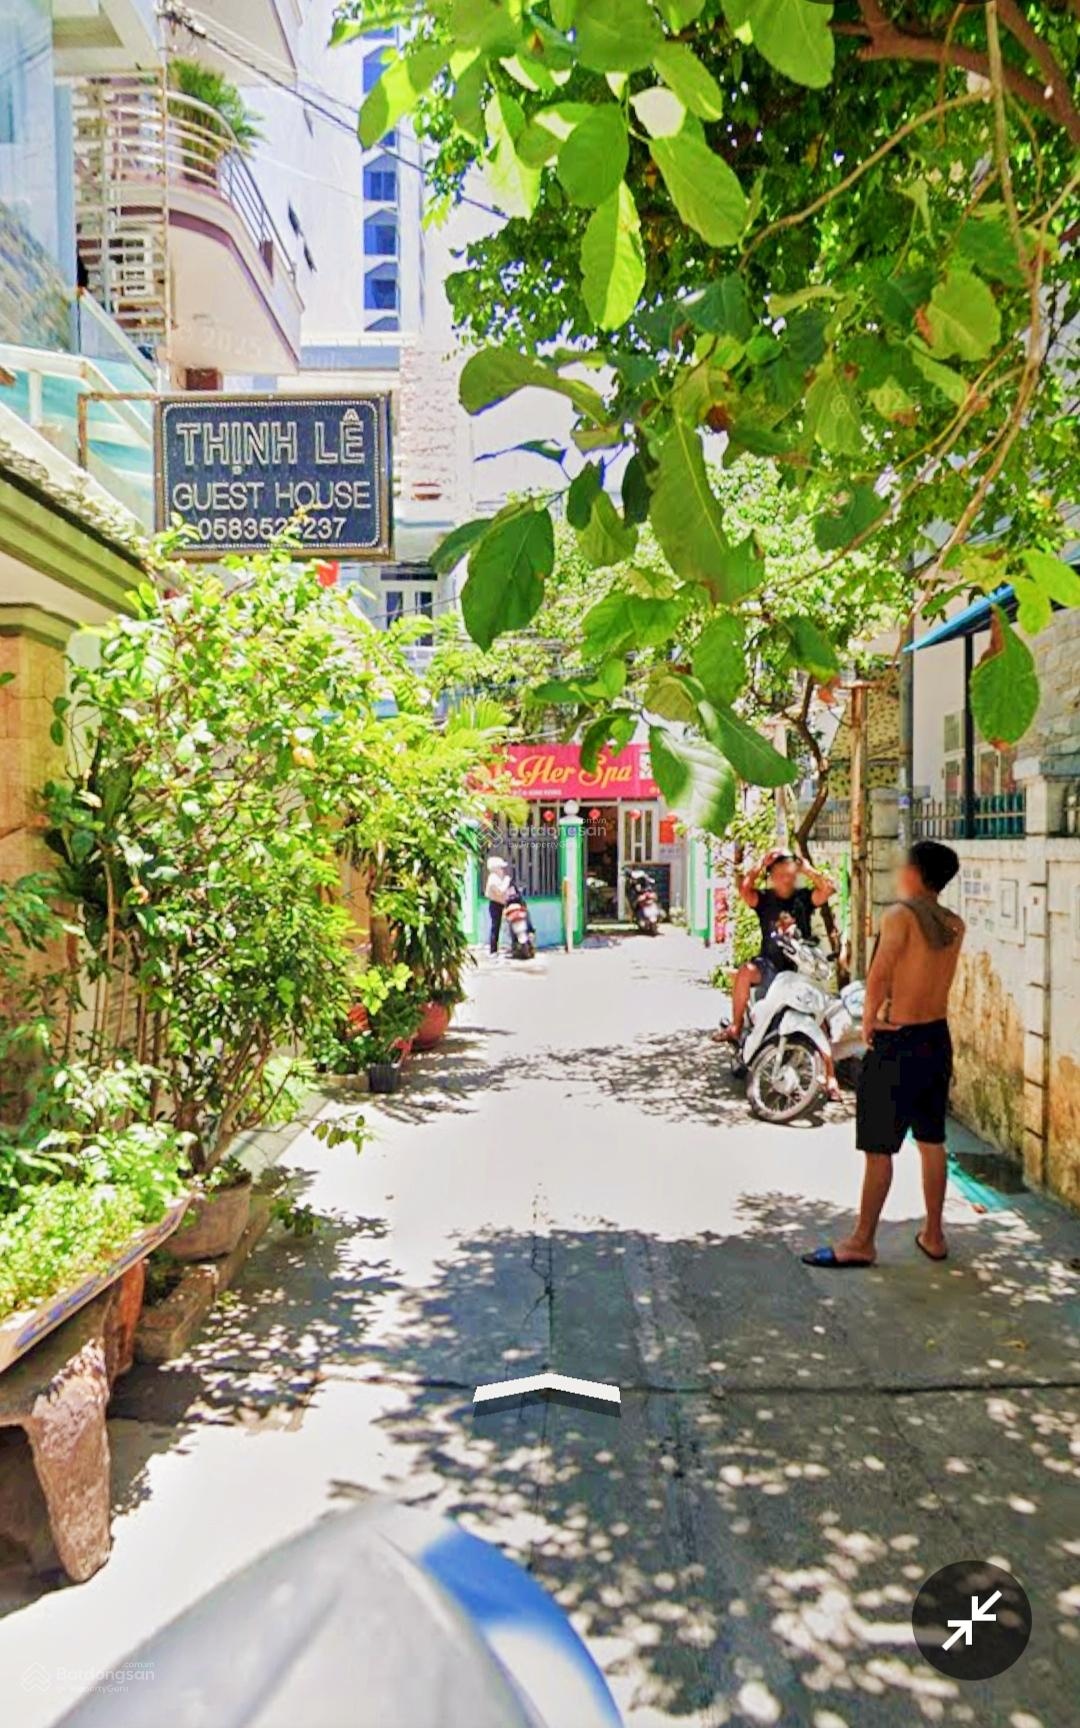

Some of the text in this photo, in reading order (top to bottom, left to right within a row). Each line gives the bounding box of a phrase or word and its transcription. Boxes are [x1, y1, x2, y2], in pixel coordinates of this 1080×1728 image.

[175, 408, 365, 475] THỊNH LÊ
[172, 481, 372, 511] GUEST HOUSE
[518, 754, 576, 787] Her
[578, 753, 633, 789] Spa
